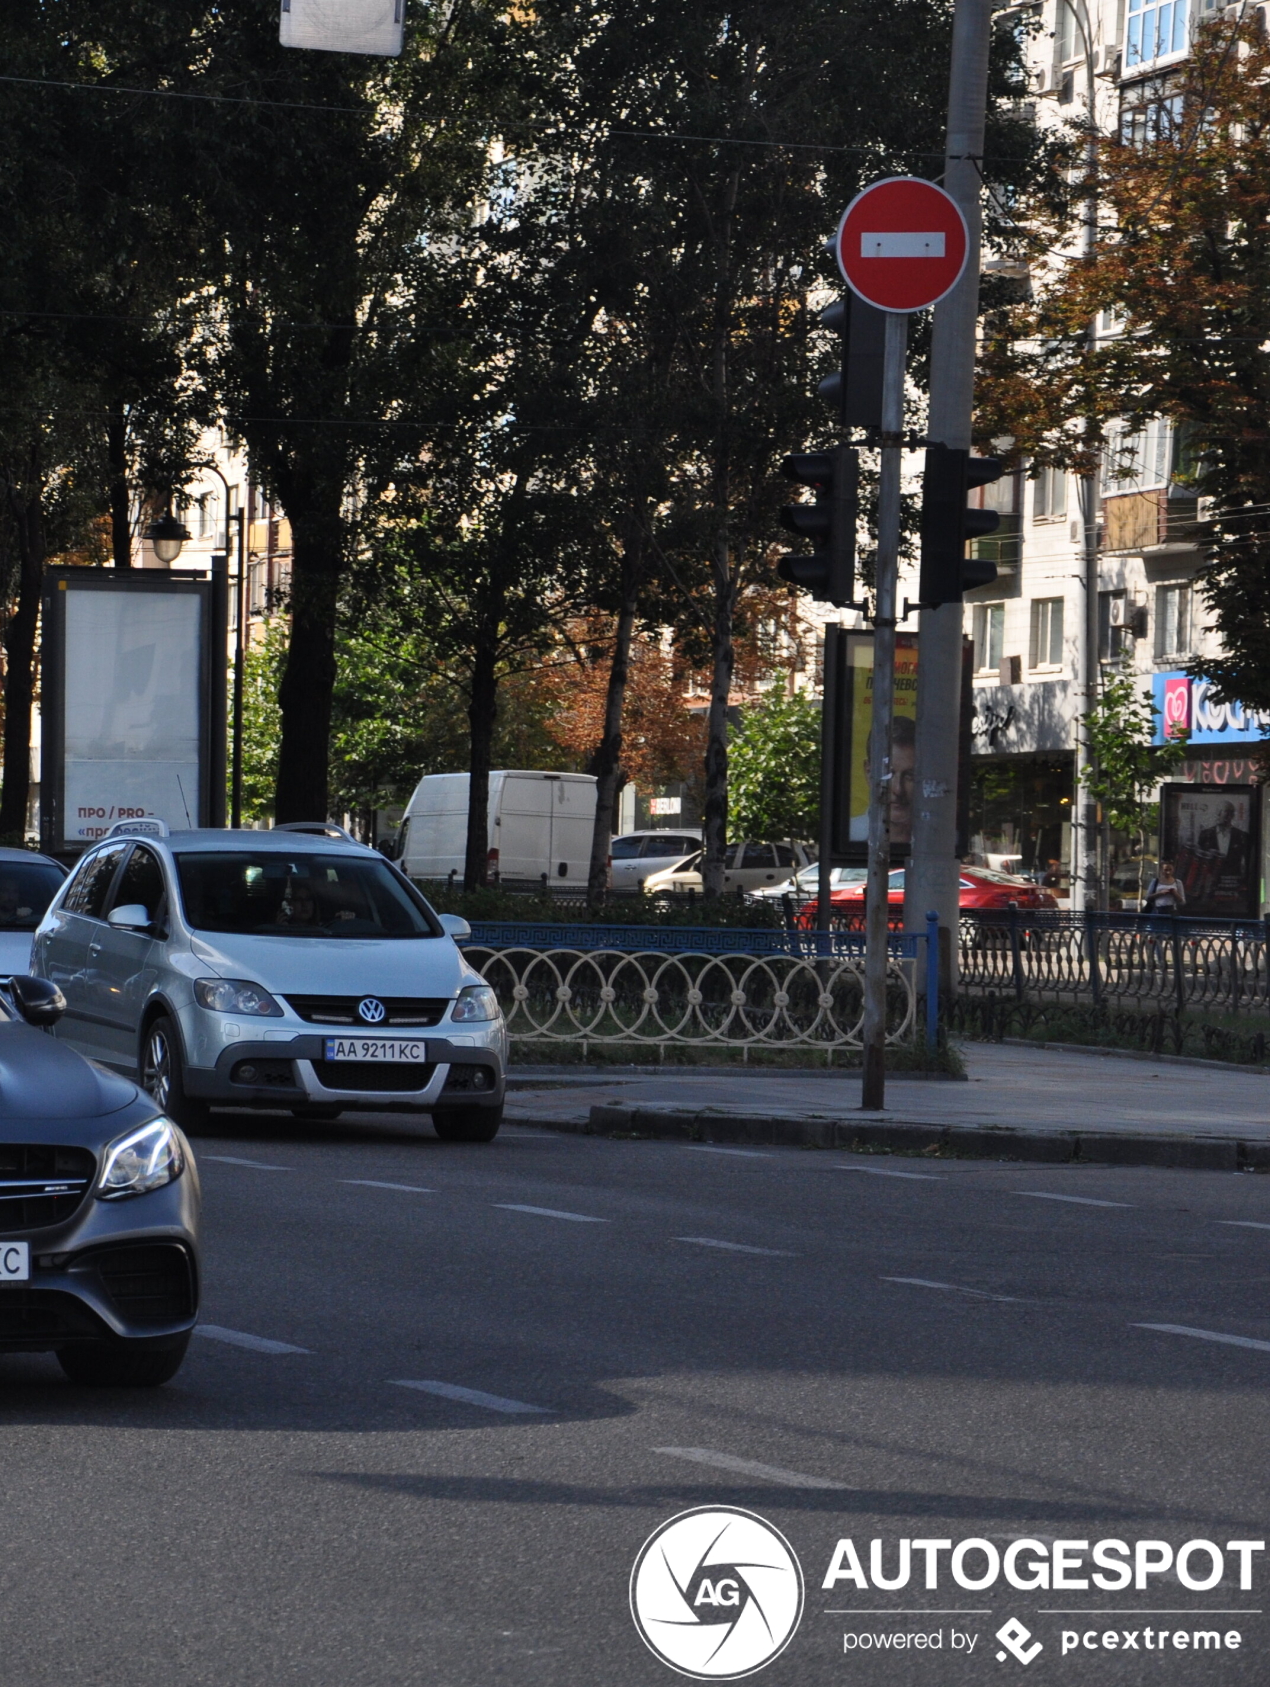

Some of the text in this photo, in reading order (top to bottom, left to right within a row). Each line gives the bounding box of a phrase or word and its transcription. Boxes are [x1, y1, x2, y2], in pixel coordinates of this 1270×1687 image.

[78, 807, 106, 818] ПРО
[118, 808, 145, 818] PRO
[335, 1041, 420, 1059] AA 9211 KC
